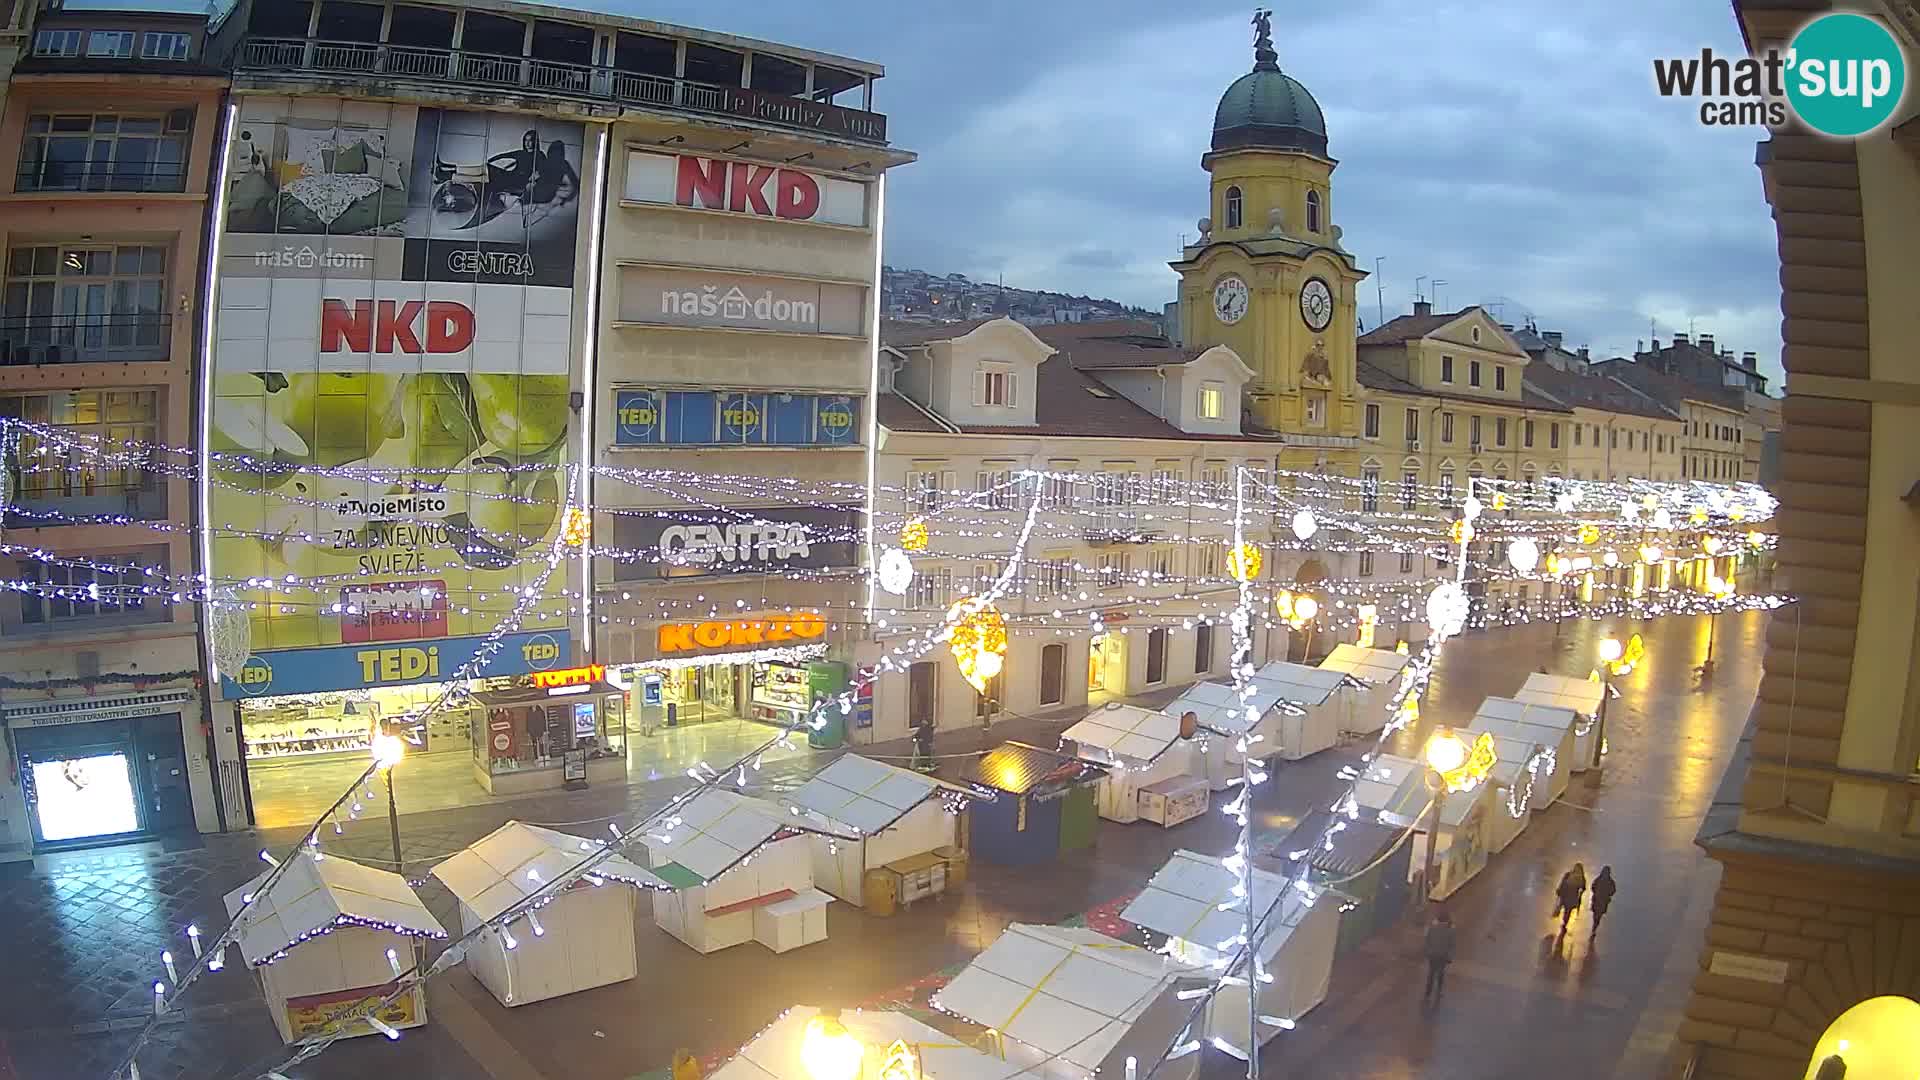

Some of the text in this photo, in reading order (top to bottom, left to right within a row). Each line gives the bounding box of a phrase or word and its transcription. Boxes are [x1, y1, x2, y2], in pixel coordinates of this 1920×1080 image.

[676, 155, 820, 220] NKD
[255, 247, 365, 269] naš dom
[448, 250, 534, 276] CENTRA
[662, 284, 816, 324] naš dom
[320, 298, 476, 354] NKD
[619, 408, 658, 425] TEDi
[723, 410, 760, 426] TEDi
[819, 411, 853, 427] TEDi
[338, 497, 446, 516] #TvojeMisto
[333, 525, 450, 549] ZA DNEVNO
[659, 522, 810, 563] CENTRA
[359, 548, 425, 575] SVJEŽE
[658, 614, 825, 652] KORZO
[357, 646, 440, 683] TEDi
[522, 643, 559, 661] TEDi
